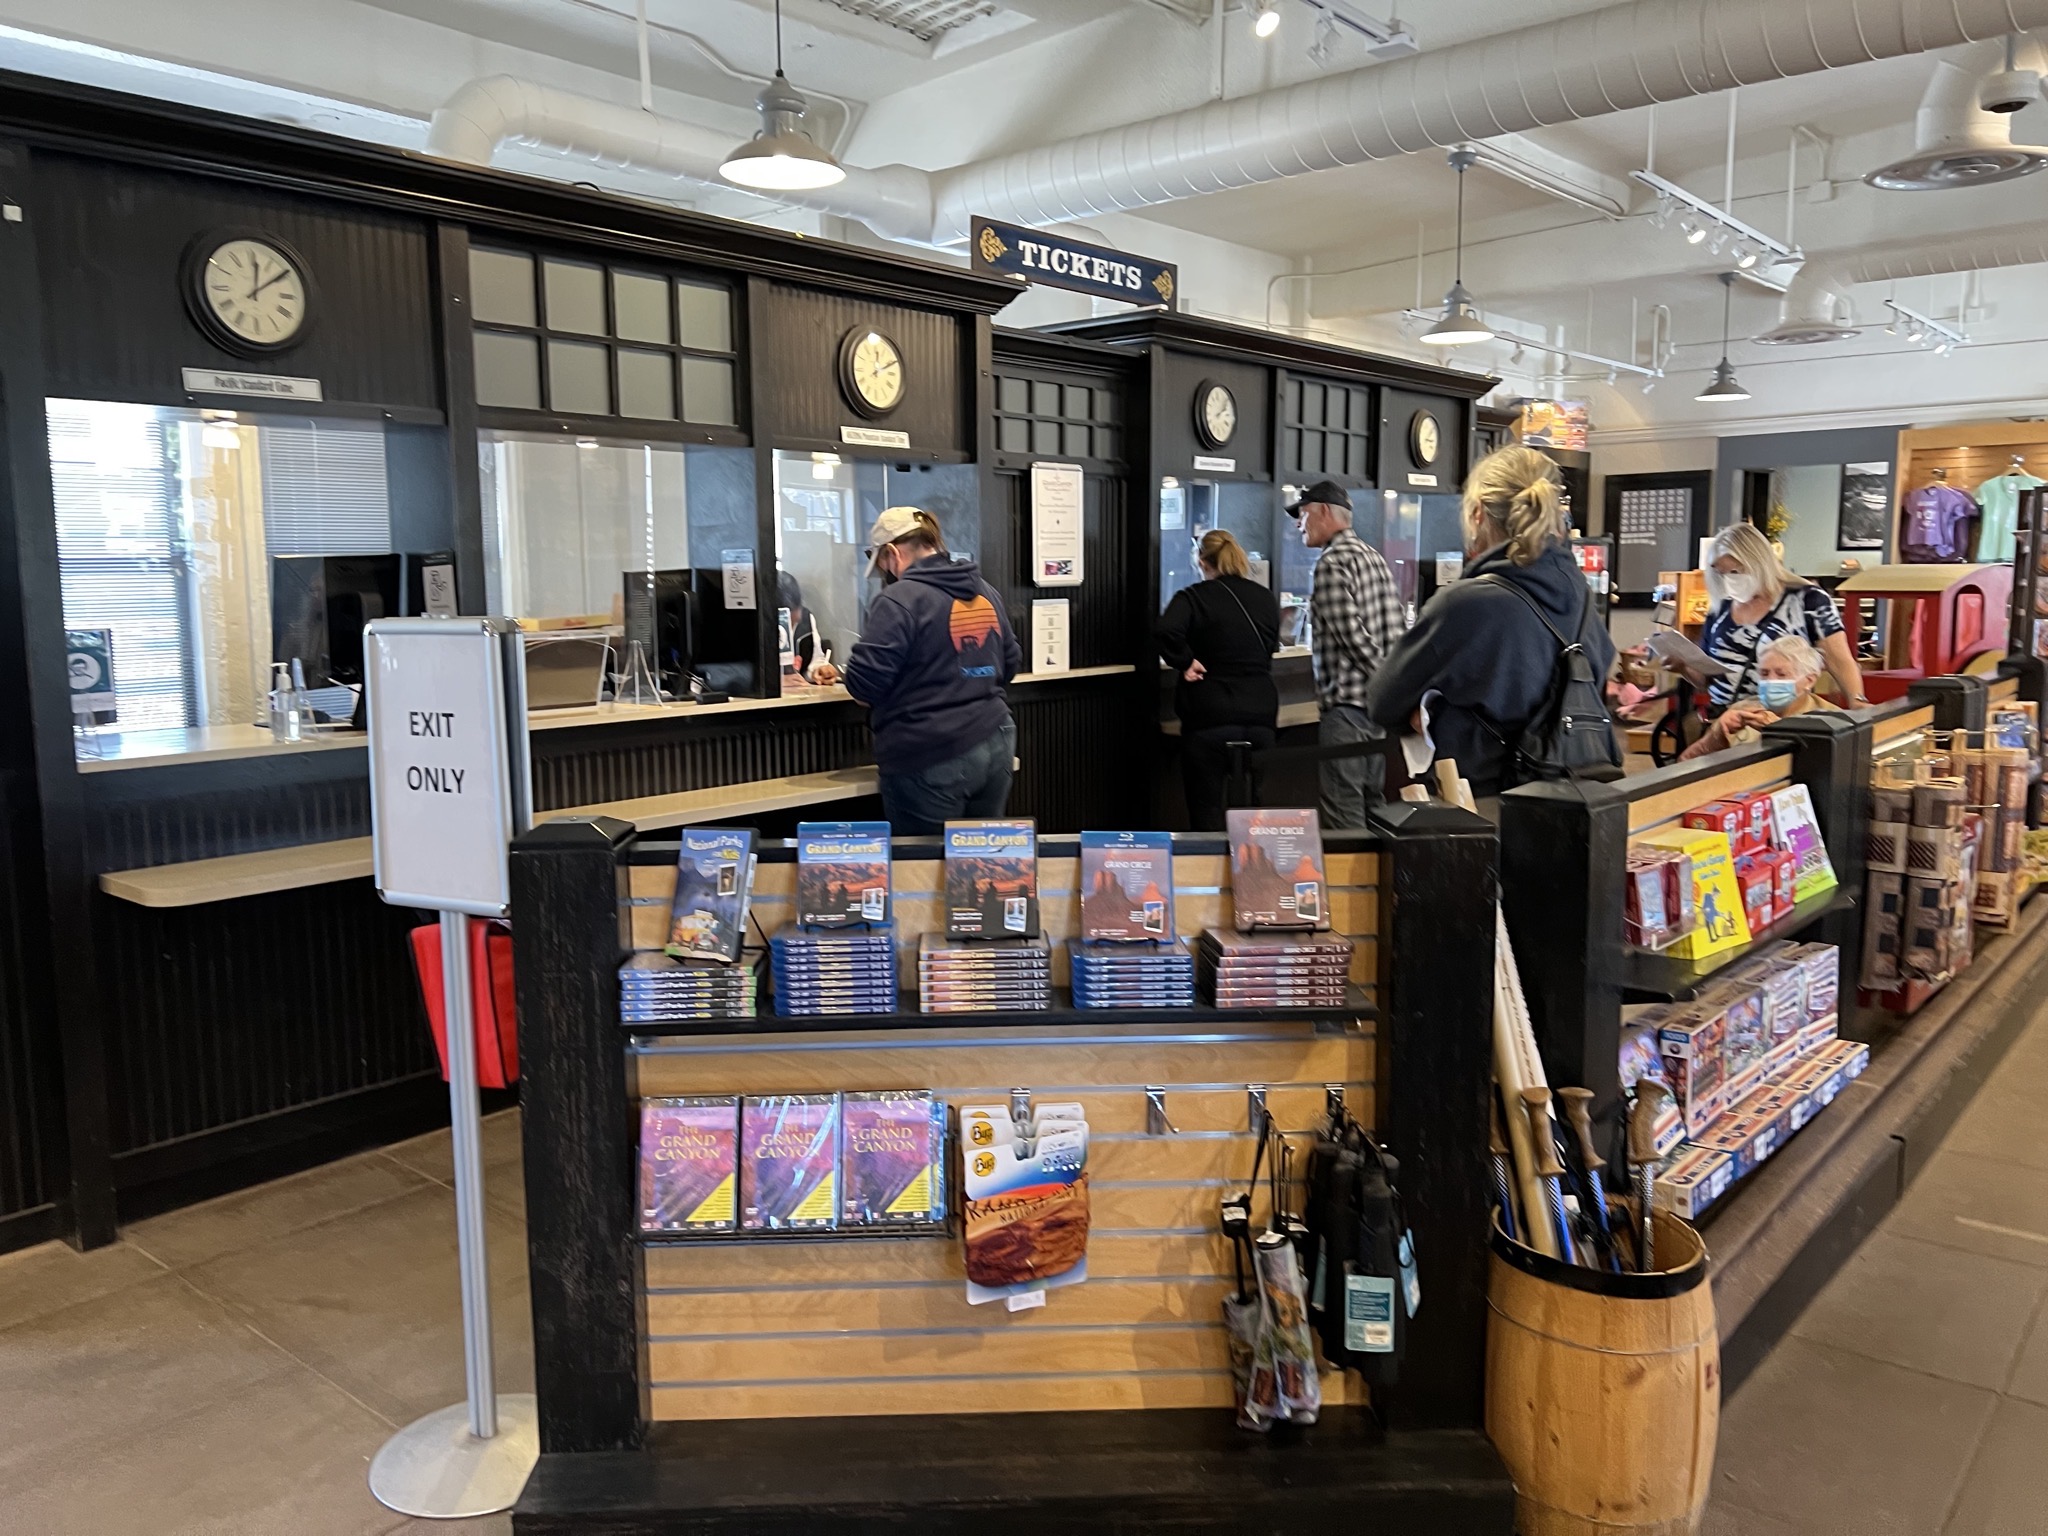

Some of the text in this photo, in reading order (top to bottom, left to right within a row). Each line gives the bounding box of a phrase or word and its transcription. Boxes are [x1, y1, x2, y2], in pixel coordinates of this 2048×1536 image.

[1018, 240, 1142, 290] TICKETS
[410, 711, 454, 738] EXIT
[407, 766, 464, 794] ONLY
[1249, 826, 1304, 835] GRAND CIRCLE
[859, 1127, 912, 1140] GRAND
[660, 1135, 716, 1147] GRAND
[854, 1140, 916, 1153] CANYON
[655, 1147, 719, 1160] CANYON
